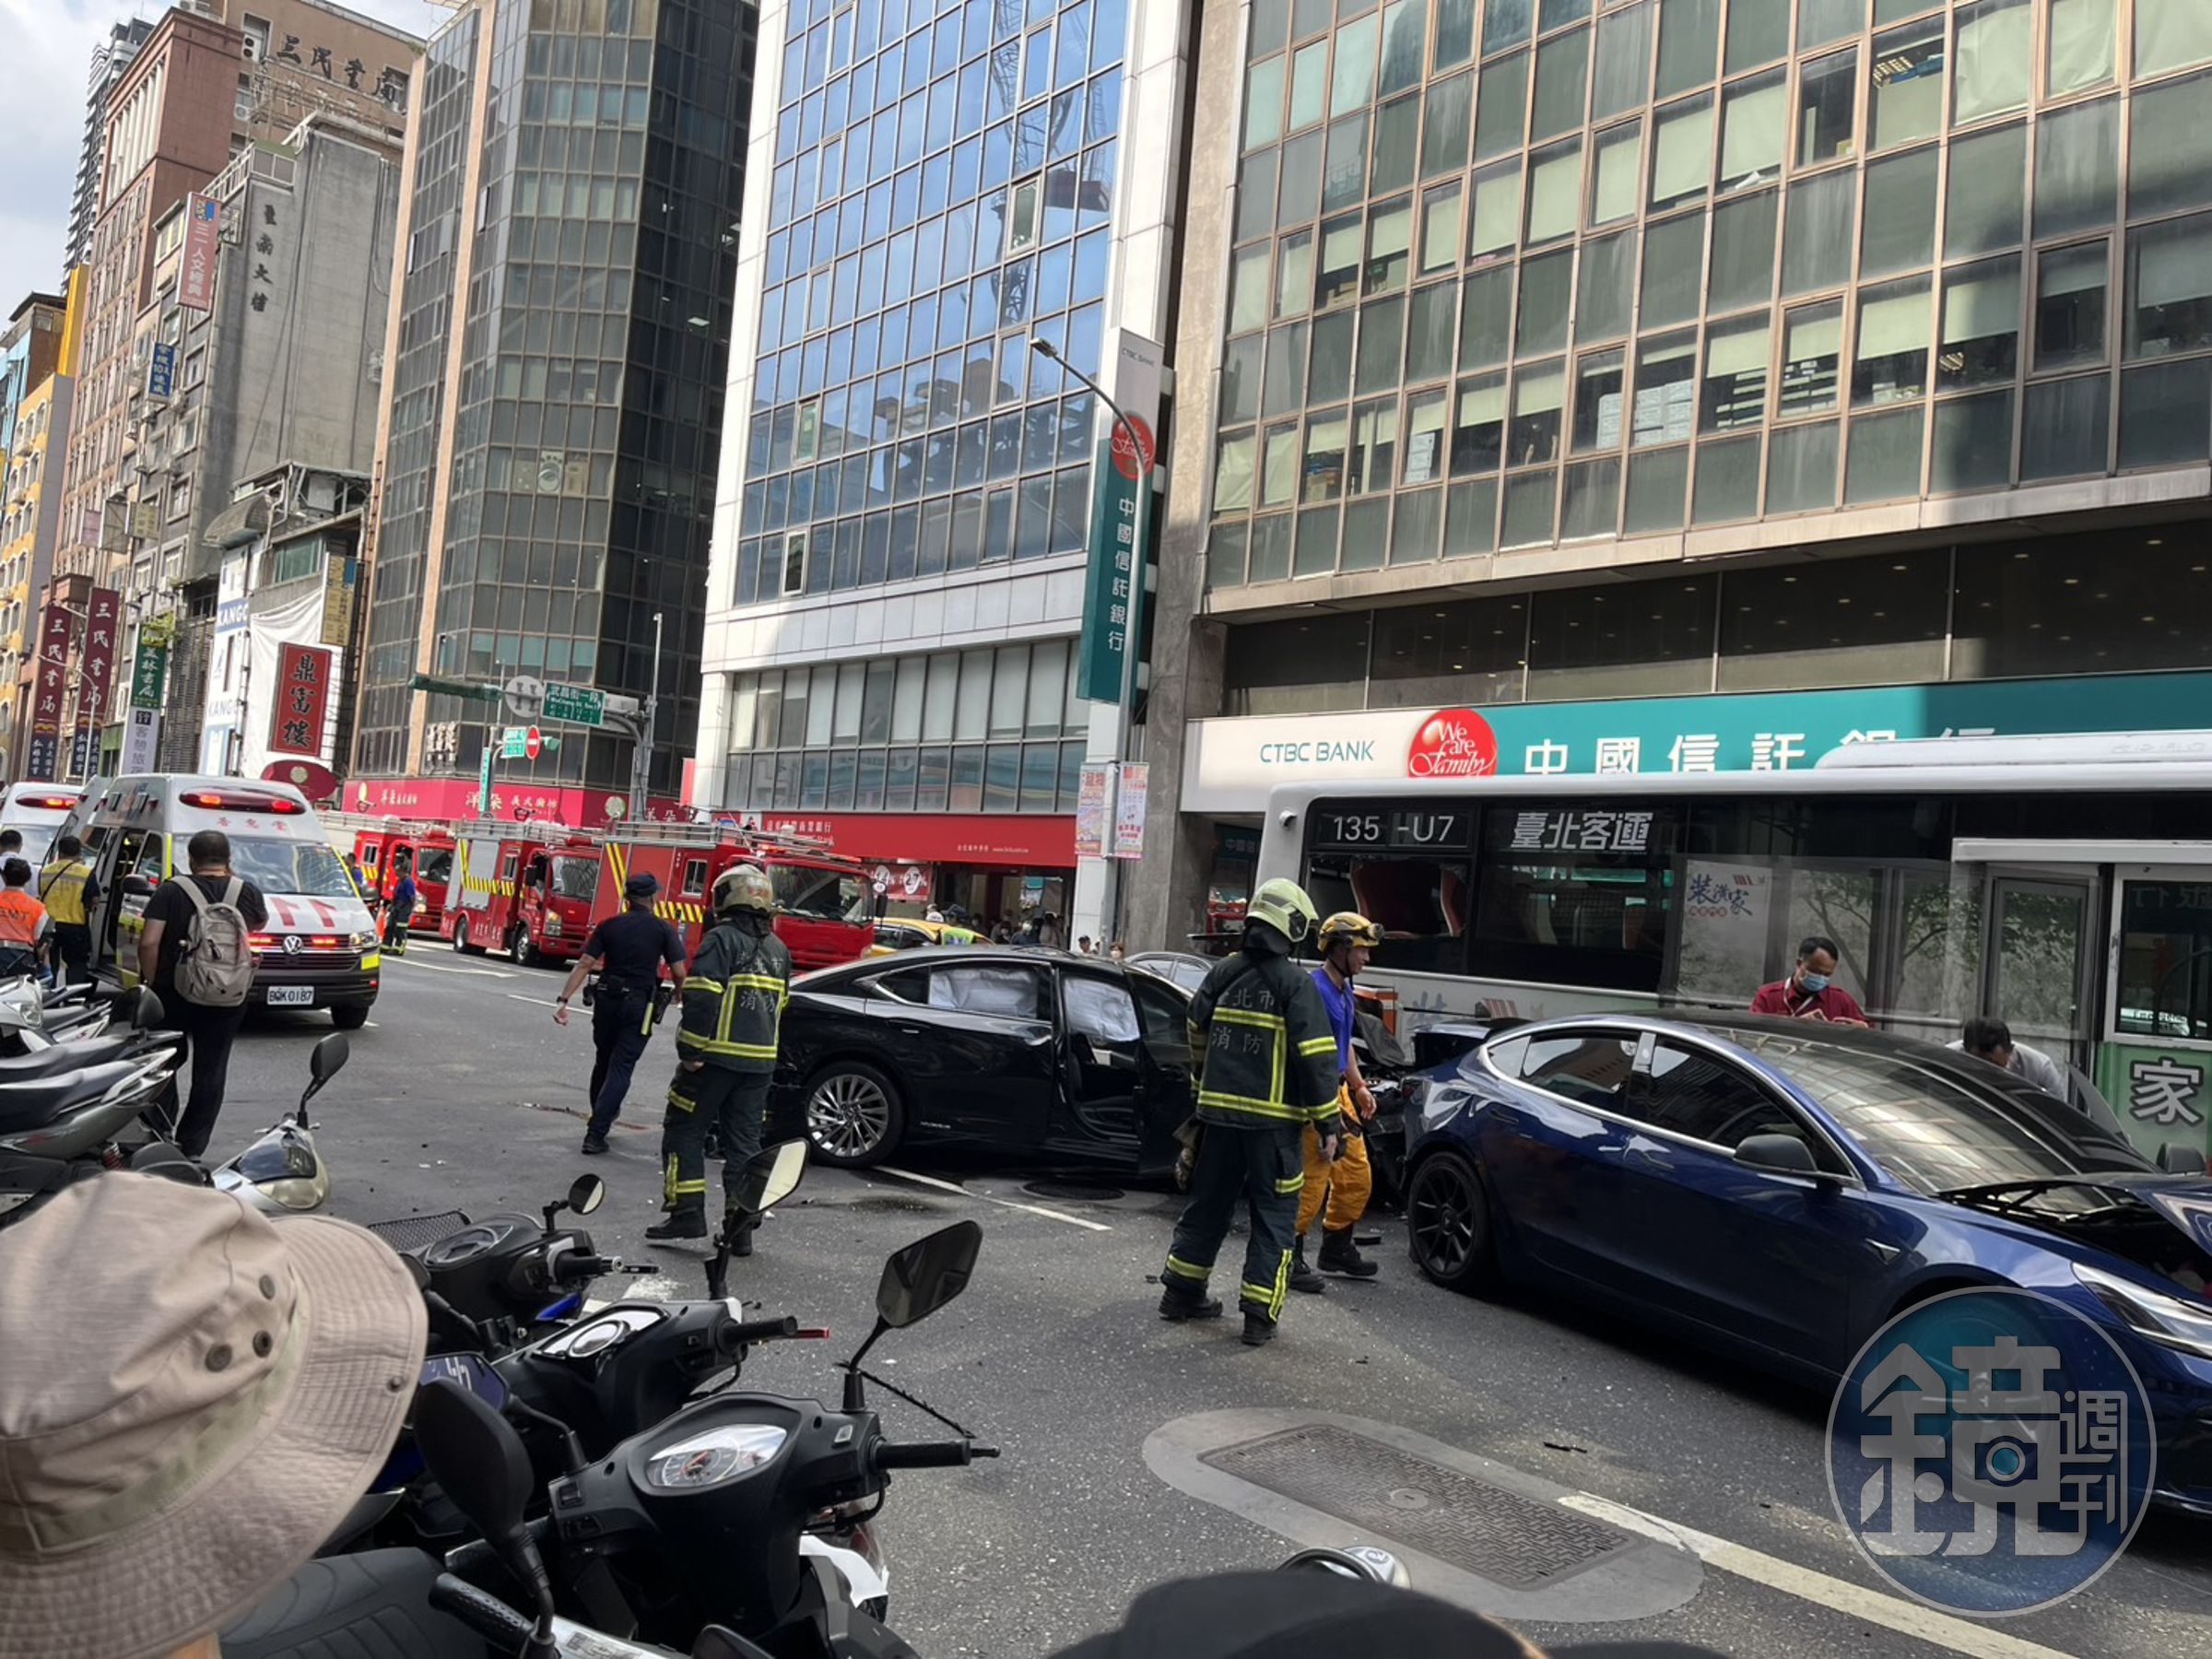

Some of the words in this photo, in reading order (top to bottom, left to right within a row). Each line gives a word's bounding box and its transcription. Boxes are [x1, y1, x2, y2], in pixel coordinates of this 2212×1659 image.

[1109, 498, 1135, 653] 中國信託銀行
[40, 618, 65, 714] 三民書局
[84, 602, 112, 706] 三民書局
[1260, 743, 1311, 763] CTBC
[1316, 739, 1375, 761] BANK
[1510, 811, 1654, 852] 臺北客運
[1687, 874, 1753, 916] 裝潢家
[739, 988, 777, 1013] 消防
[1211, 1026, 1263, 1055] 消防
[2131, 1058, 2204, 1126] 家
